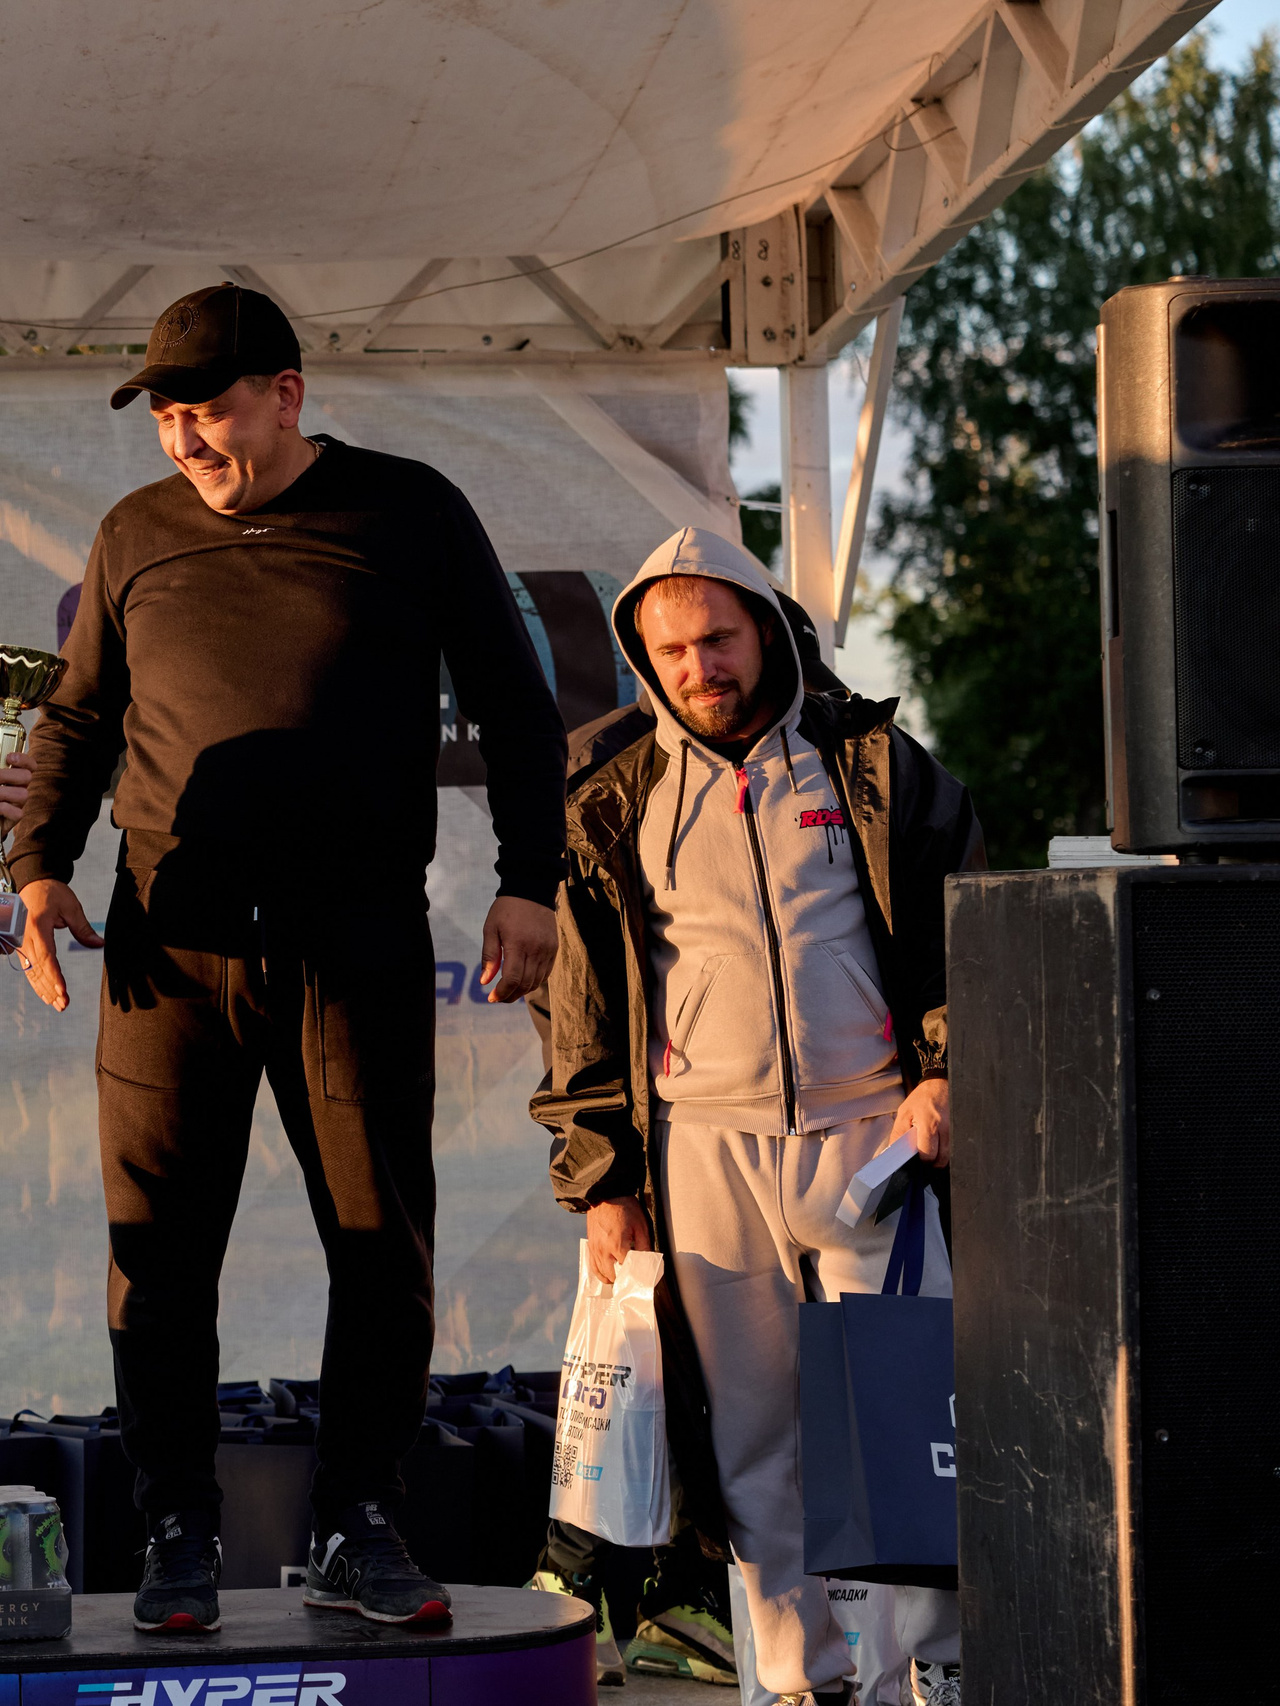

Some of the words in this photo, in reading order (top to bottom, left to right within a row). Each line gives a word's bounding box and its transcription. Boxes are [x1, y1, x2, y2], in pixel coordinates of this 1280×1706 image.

[800, 809, 846, 829] RDS
[827, 1588, 868, 1602] РИСАДКИ
[110, 1672, 347, 1706] HYPER
